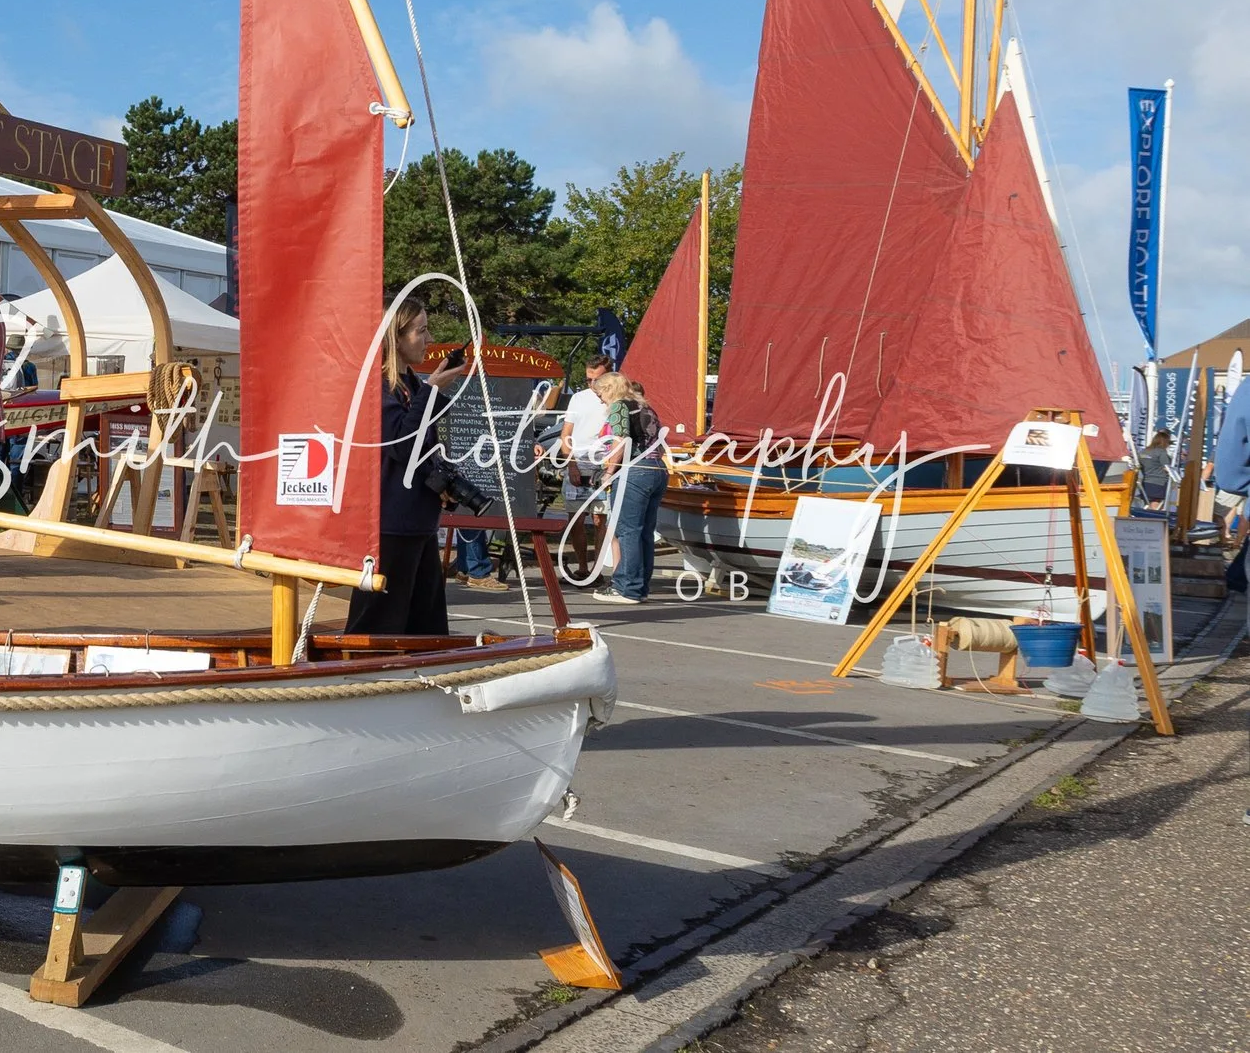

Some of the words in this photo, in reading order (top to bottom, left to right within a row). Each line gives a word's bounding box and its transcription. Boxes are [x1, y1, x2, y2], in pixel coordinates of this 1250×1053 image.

[14, 124, 116, 190] STAGE
[512, 351, 552, 371] STAGE
[1166, 372, 1177, 424] SPONSORED
[470, 428, 490, 436] BENDIN
[281, 481, 328, 496] Jeckells
